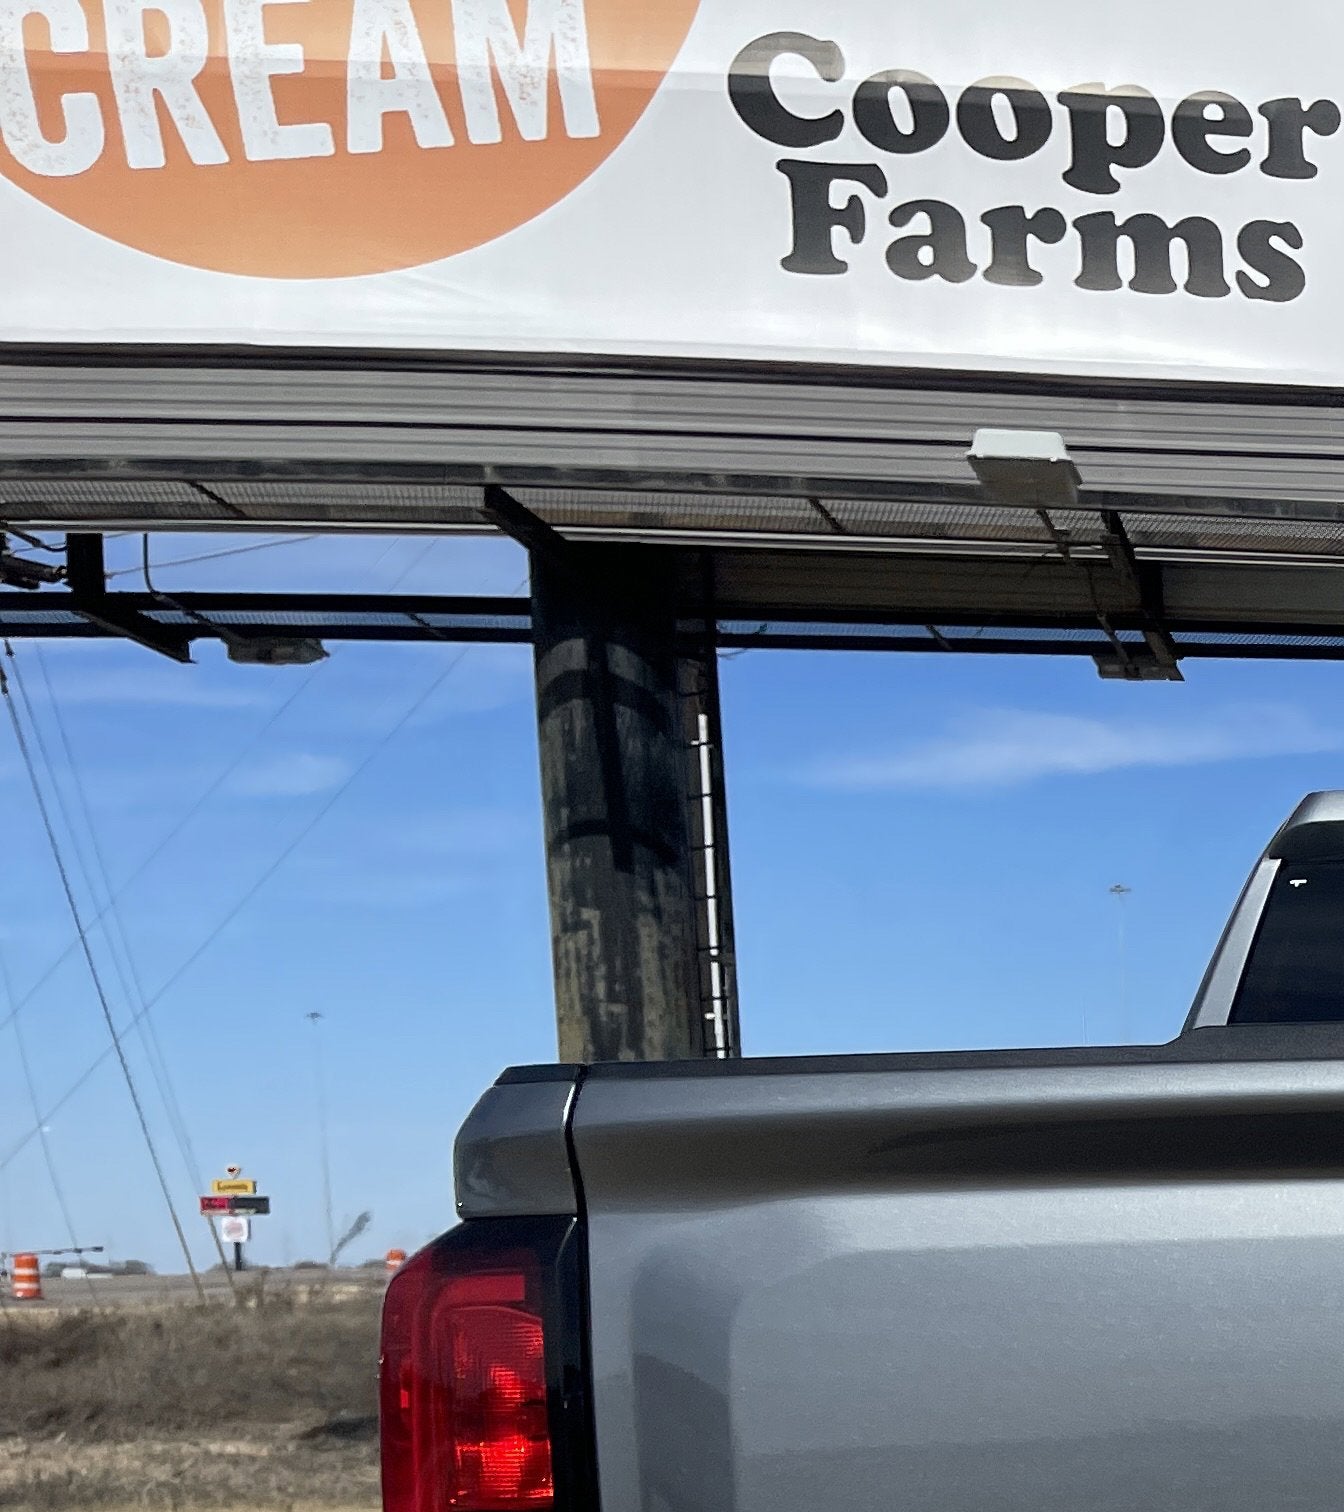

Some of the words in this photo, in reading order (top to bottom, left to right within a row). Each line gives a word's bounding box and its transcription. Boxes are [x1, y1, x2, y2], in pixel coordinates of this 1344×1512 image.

[0, 0, 600, 177] CREAM
[727, 31, 1341, 195] Cooper
[775, 158, 1306, 302] Farms
